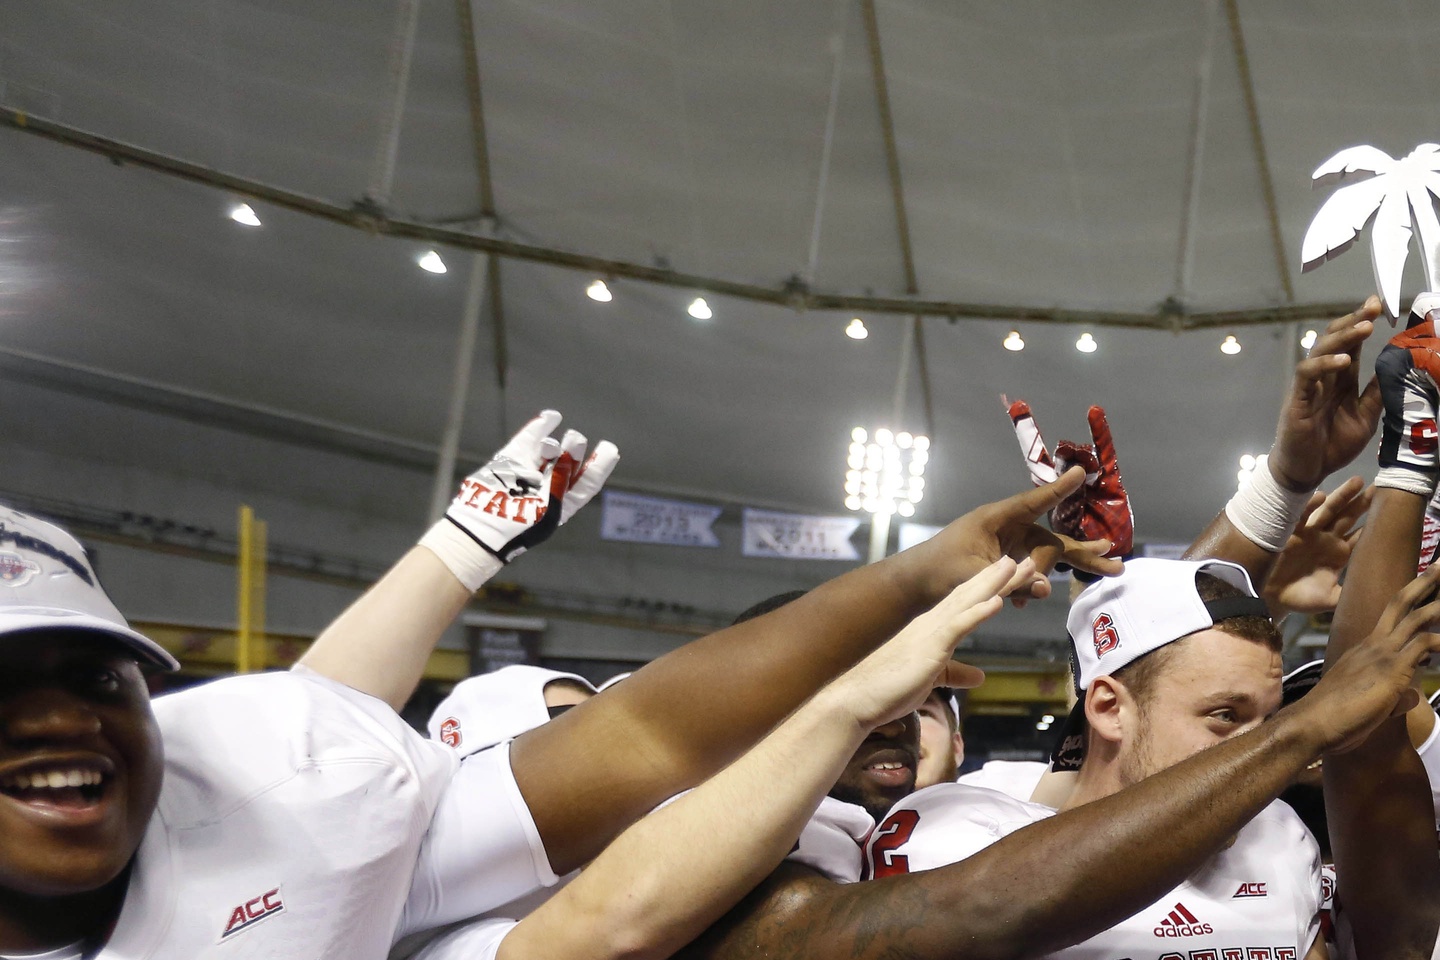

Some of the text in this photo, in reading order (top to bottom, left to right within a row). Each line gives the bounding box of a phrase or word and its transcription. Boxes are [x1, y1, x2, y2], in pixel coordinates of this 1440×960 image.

[1234, 882, 1268, 897] ACC
[222, 886, 285, 938] ACC
[1153, 921, 1214, 938] adidas
